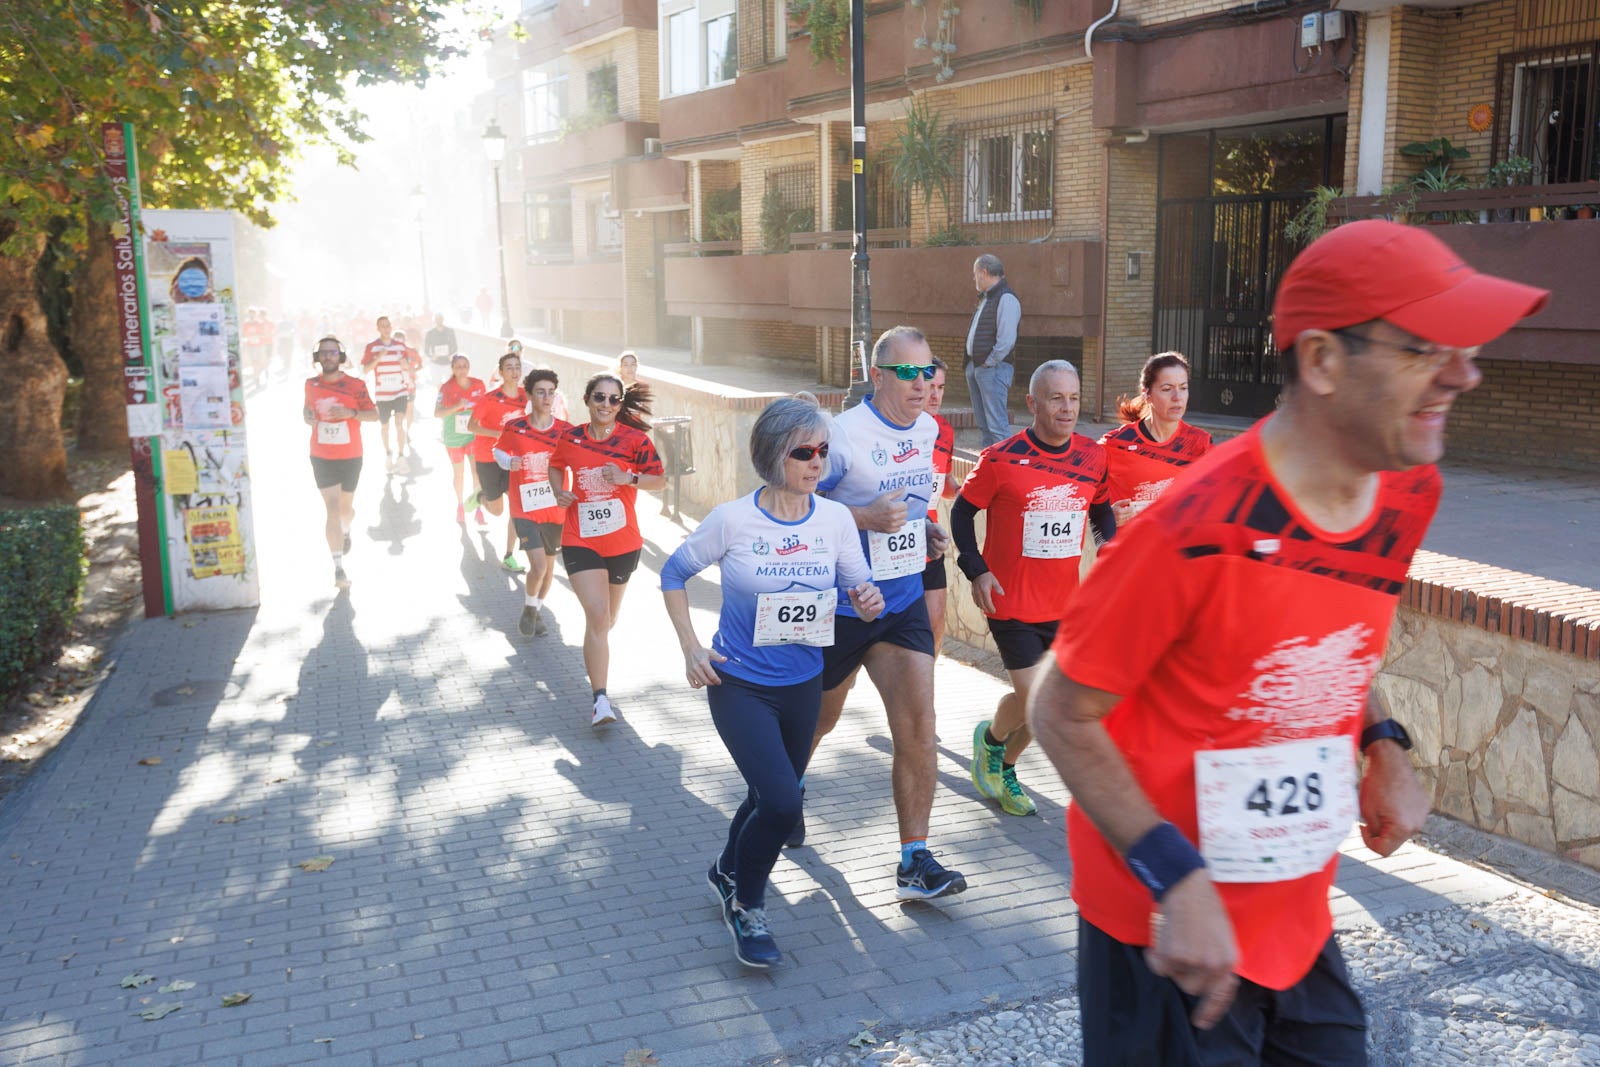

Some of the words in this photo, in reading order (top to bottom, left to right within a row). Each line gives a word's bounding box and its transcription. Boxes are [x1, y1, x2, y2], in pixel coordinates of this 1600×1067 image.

[879, 473, 932, 491] MARACEN
[527, 486, 551, 498] 1784
[1028, 500, 1082, 510] carrera
[587, 508, 611, 521] 369
[1040, 521, 1071, 537] 164
[782, 534, 800, 550] 35
[888, 532, 916, 552] 628
[755, 565, 830, 577] MARACENA
[778, 604, 817, 623] 629
[1246, 772, 1323, 817] 428
